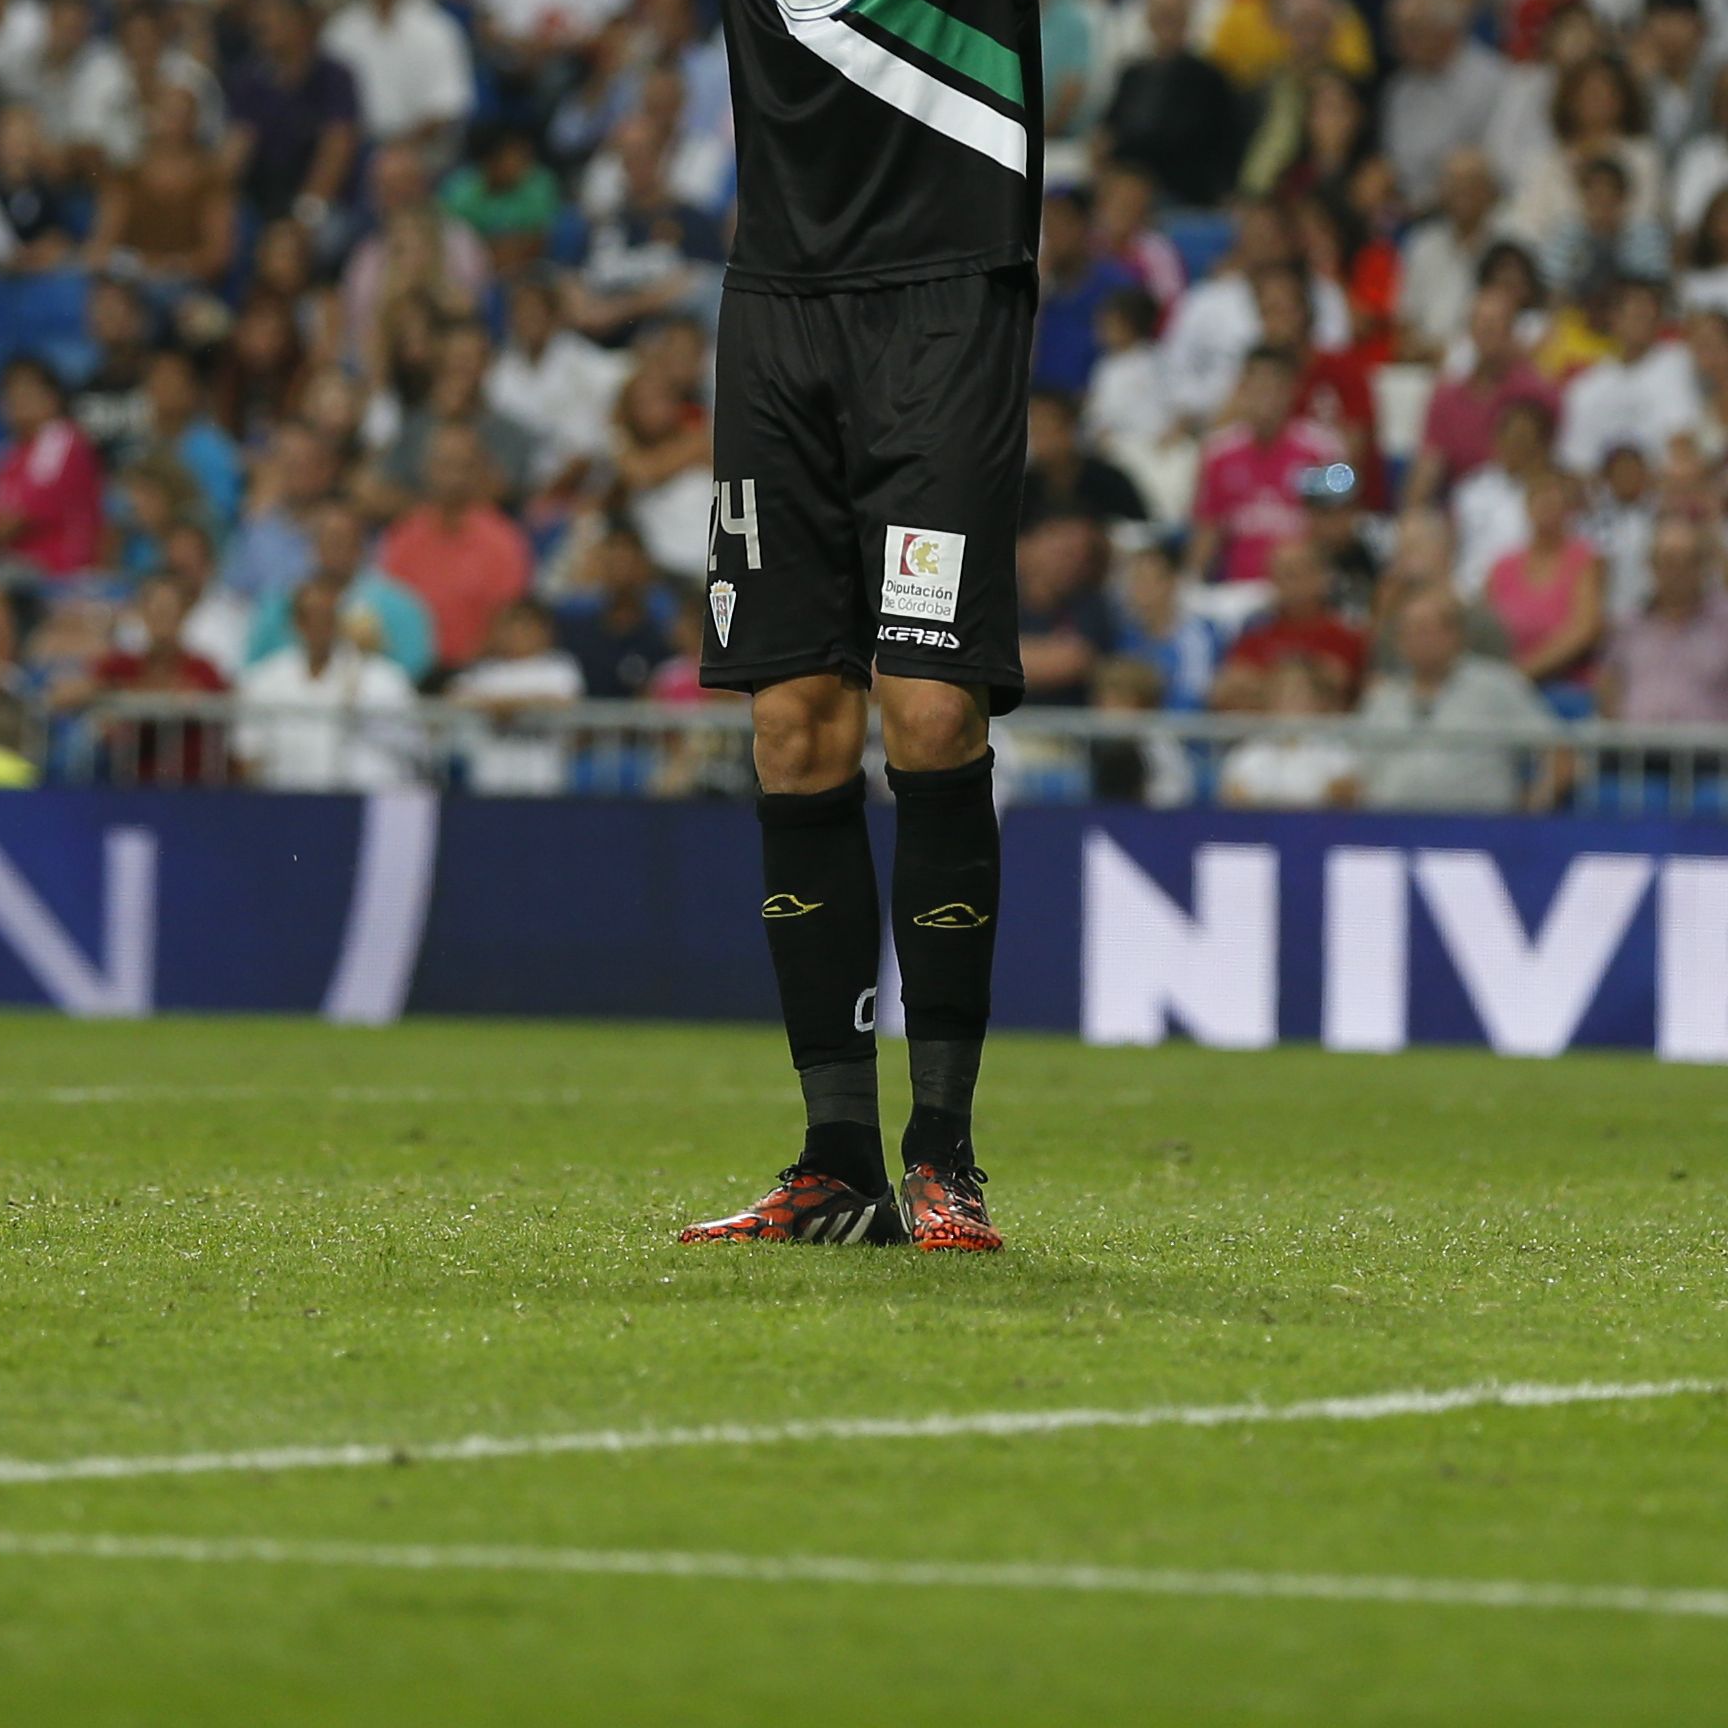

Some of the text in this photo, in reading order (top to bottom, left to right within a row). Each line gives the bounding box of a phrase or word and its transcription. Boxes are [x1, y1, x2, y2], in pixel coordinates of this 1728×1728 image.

[885, 579, 953, 601] Diputación
[897, 597, 952, 617] Córdoba
[876, 624, 961, 649] ACERBIS
